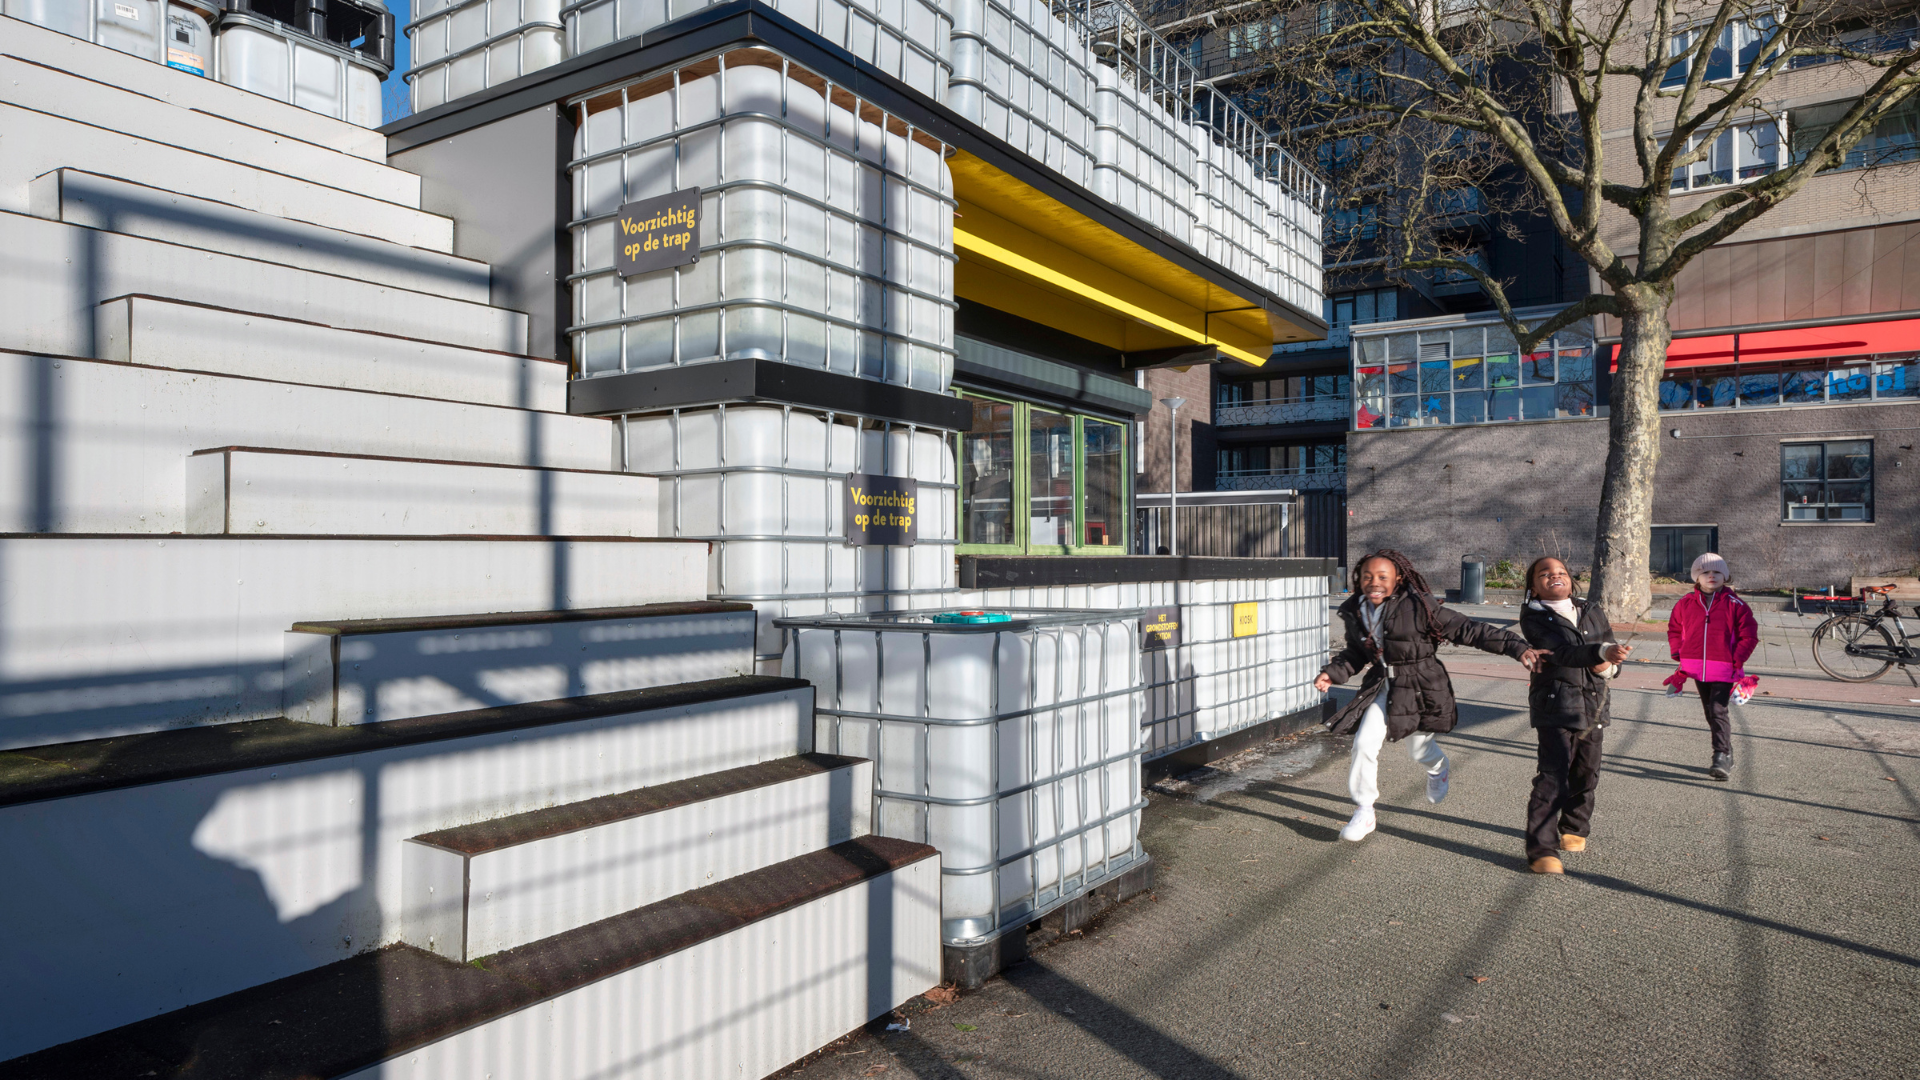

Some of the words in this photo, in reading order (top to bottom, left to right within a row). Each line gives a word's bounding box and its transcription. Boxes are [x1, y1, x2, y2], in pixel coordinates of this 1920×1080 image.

[621, 204, 695, 236] Voorzichtig
[624, 243, 641, 261] op
[643, 233, 660, 252] de
[663, 232, 691, 251] trap
[850, 487, 915, 515] Voorzichtig
[854, 514, 870, 532] op
[872, 508, 887, 526] de
[889, 513, 912, 533] trap
[1157, 614, 1167, 622] HET
[1239, 615, 1253, 625] KIOSK
